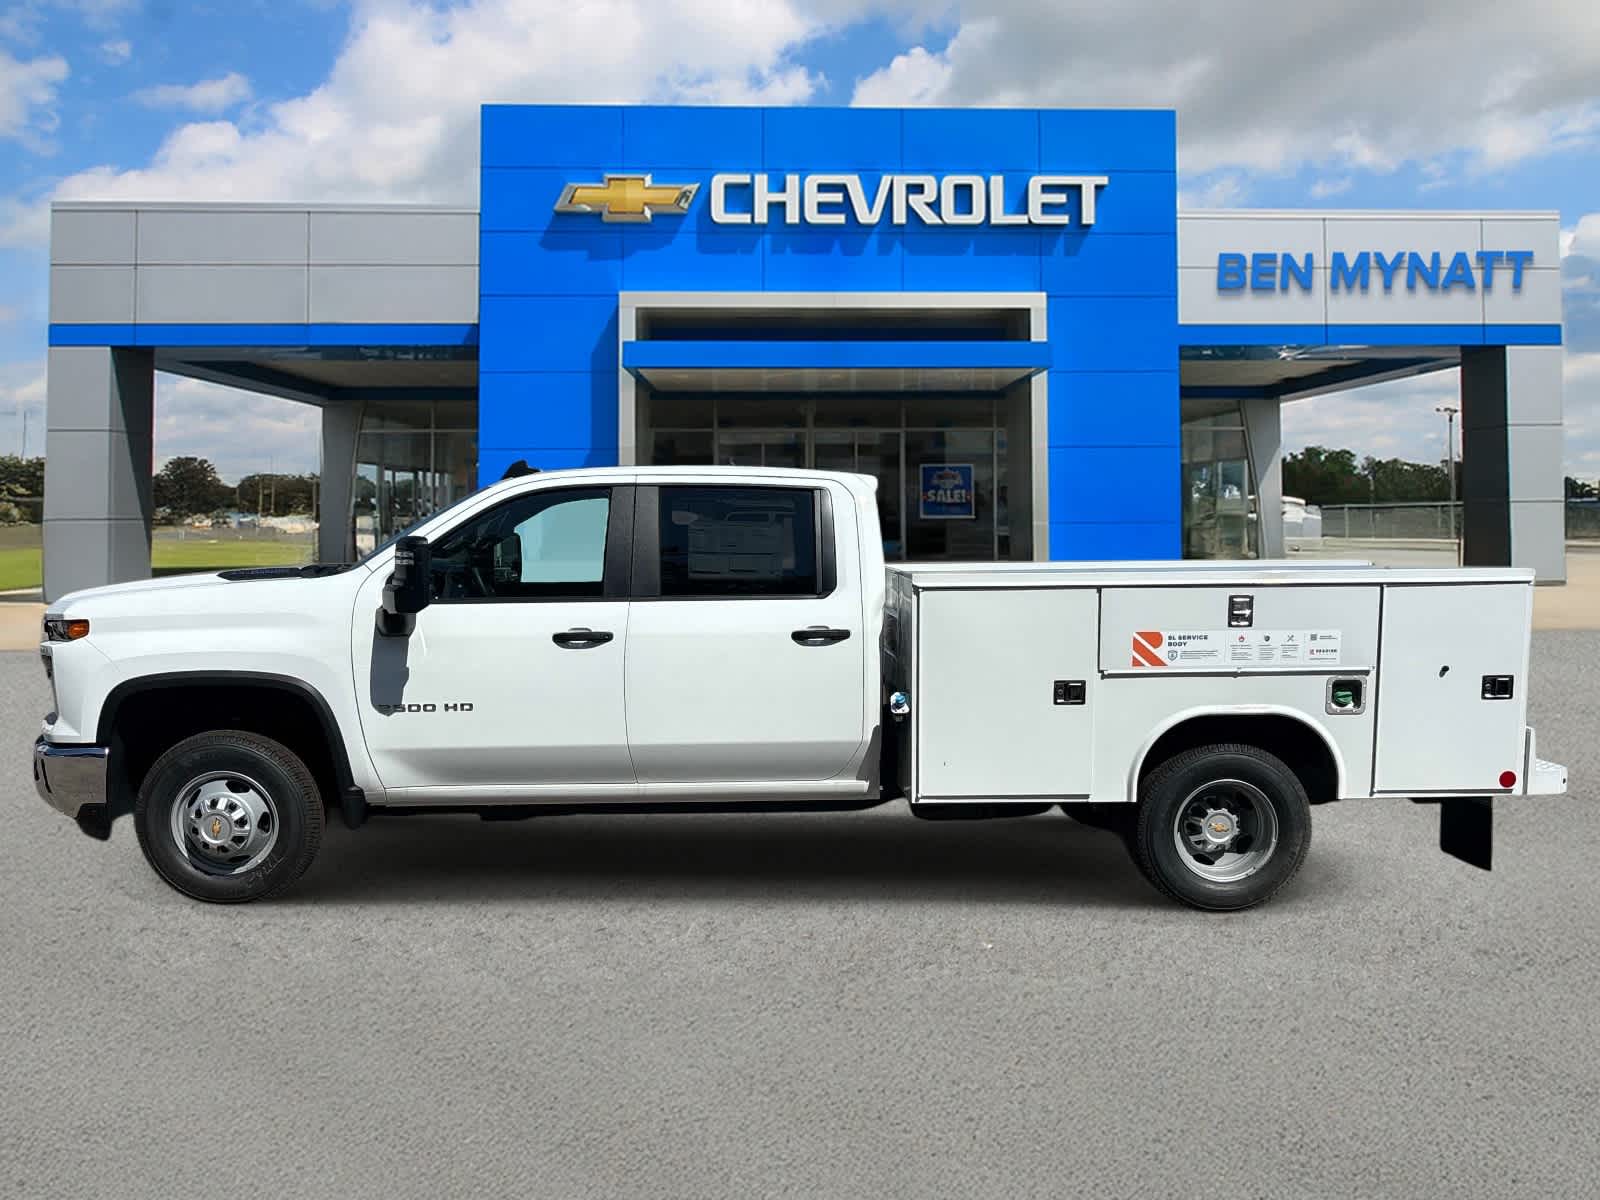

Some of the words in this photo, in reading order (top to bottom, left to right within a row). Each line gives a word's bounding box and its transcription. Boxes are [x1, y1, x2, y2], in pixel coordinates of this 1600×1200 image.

[710, 173, 1109, 226] CHEVROLET
[1216, 252, 1314, 291] BEN
[1330, 250, 1534, 290] MYNATT
[444, 703, 474, 712] HD
